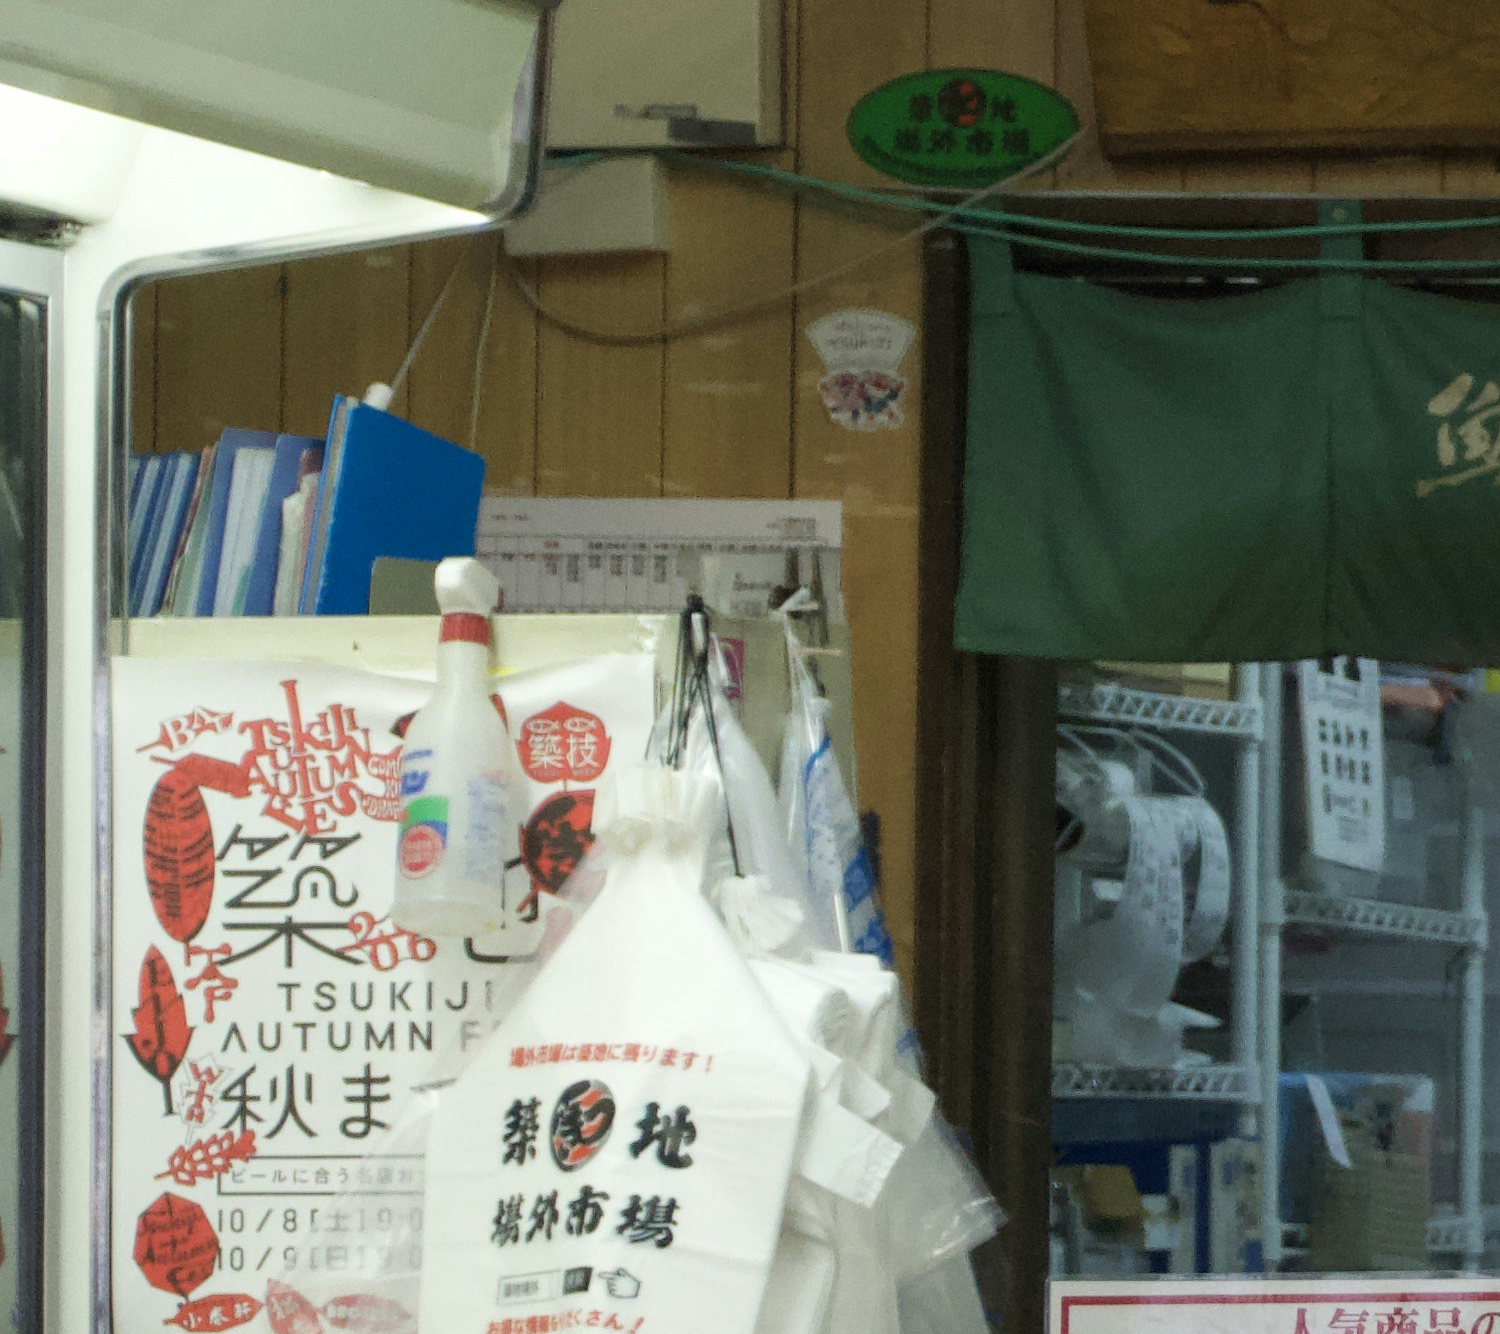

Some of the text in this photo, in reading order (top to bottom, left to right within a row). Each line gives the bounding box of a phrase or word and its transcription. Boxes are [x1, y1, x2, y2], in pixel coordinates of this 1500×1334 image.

[278, 981, 494, 1012] TSUKIJI
[221, 1022, 433, 1052] AUTUMN
[220, 1063, 457, 1139] 秋ま
[629, 1102, 698, 1169] 地
[491, 1185, 681, 1249] 場外市場
